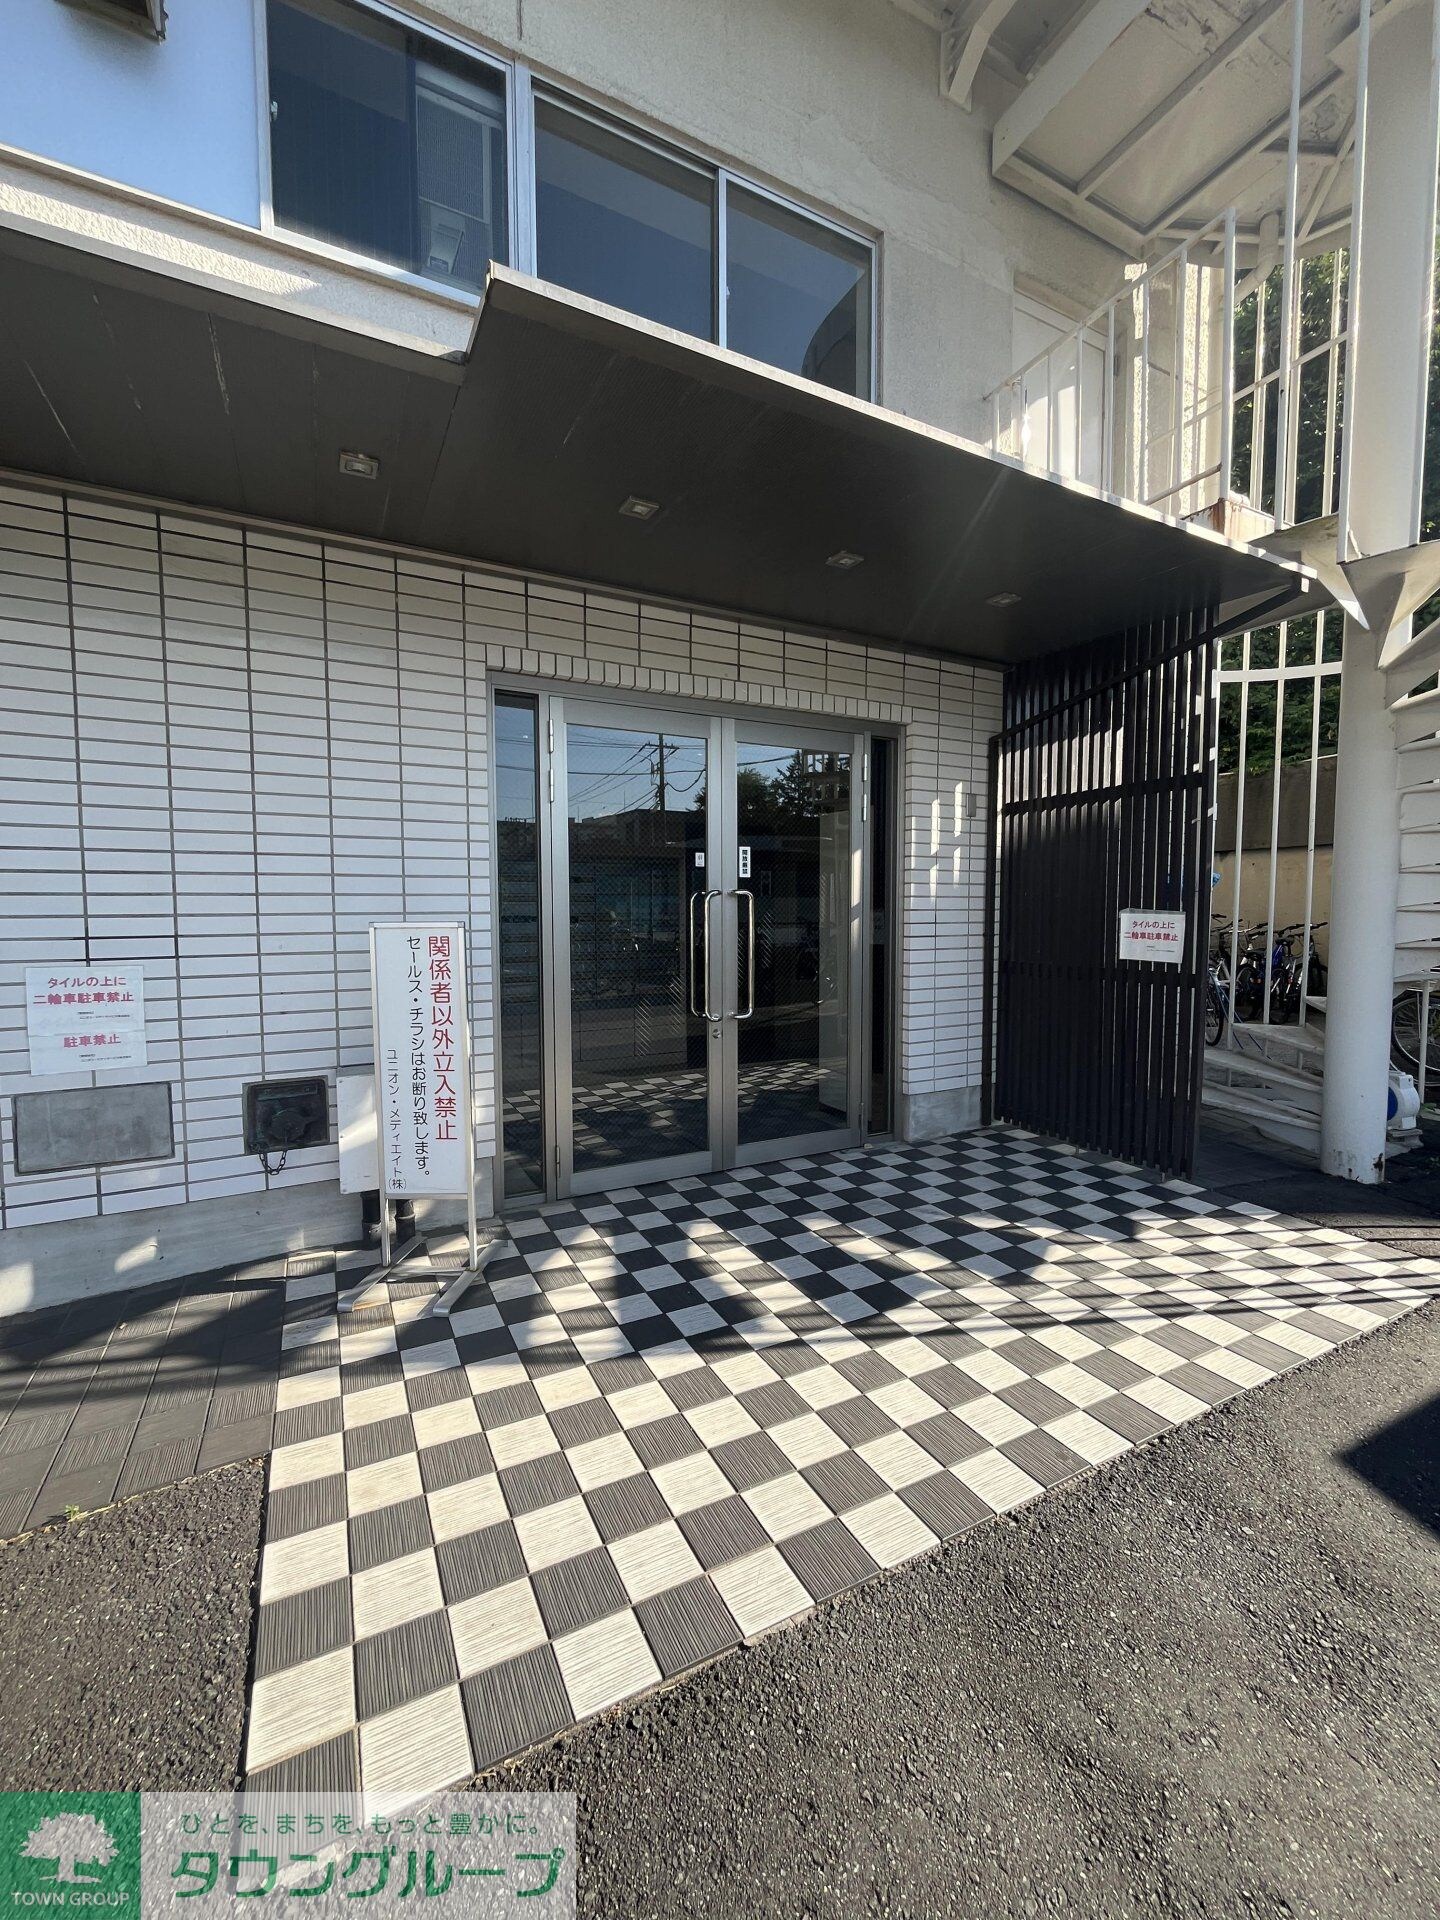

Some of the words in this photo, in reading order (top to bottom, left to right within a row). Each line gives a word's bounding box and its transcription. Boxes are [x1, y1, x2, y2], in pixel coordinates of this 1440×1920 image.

[1132, 920, 1175, 929] タイルの上に
[1124, 931, 1178, 942] 二輪車駐車禁止
[47, 976, 127, 989] タイルの上に
[33, 991, 134, 1005] 二輪車駐車禁止
[63, 1033, 121, 1048] 駐車禁止
[428, 935, 458, 1141] 関係者以外立入禁止
[406, 936, 431, 1177] セールス・チラシはお断り致します。
